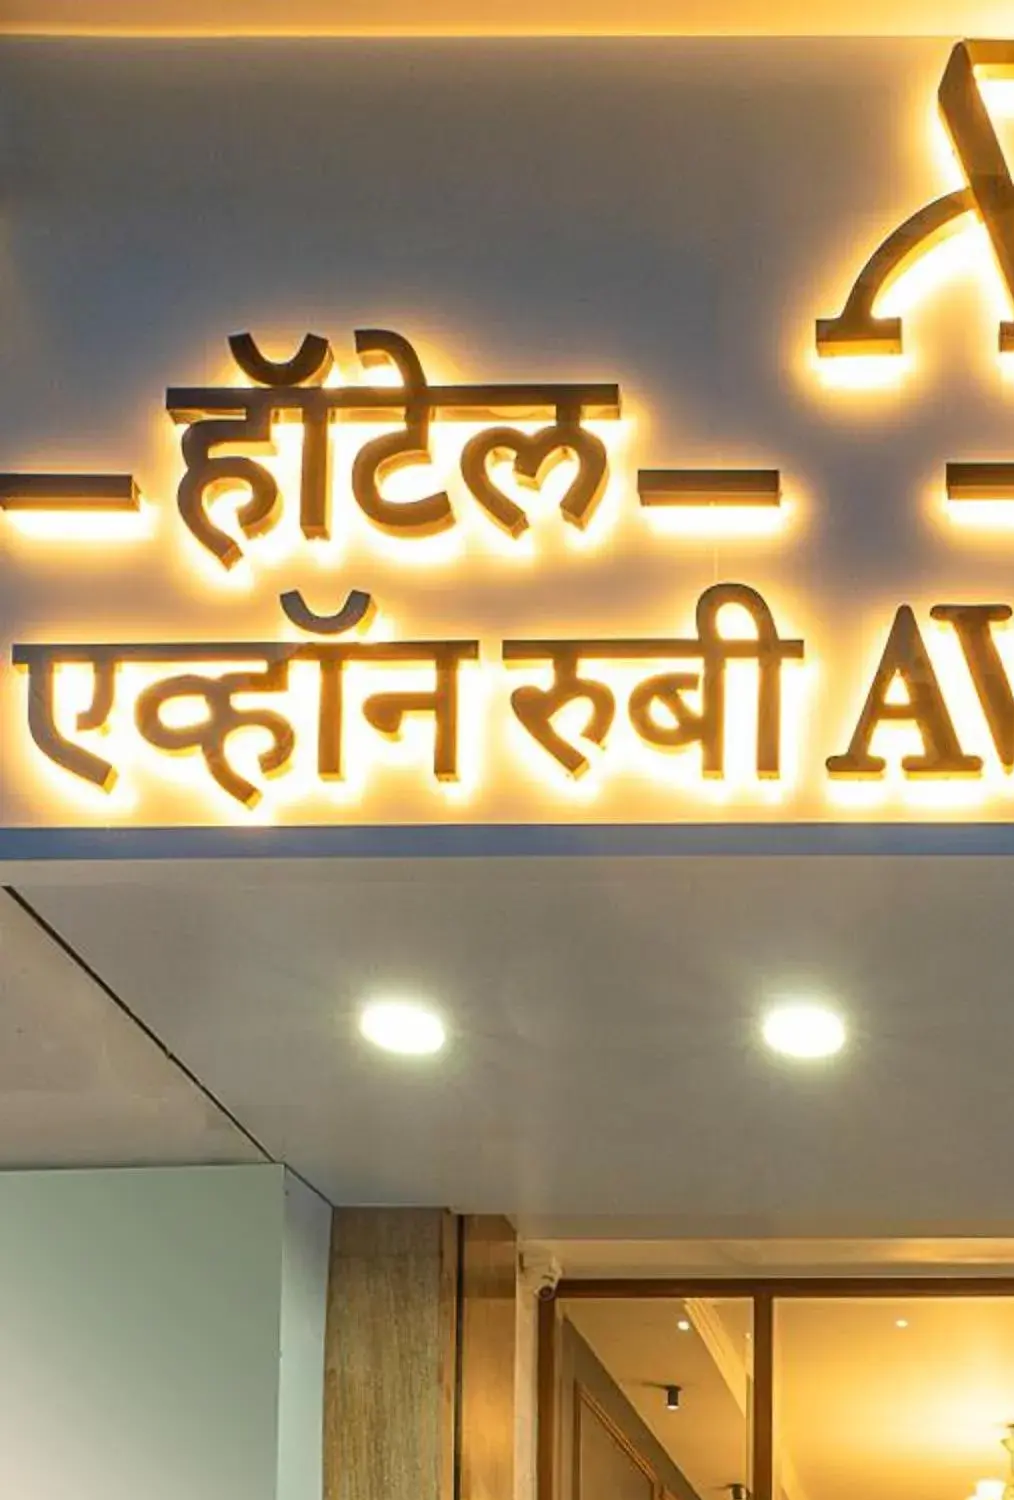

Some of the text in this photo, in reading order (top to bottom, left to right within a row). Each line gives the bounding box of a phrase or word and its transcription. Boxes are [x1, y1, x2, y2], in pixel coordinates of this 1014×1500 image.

[166, 330, 621, 571] हॉटेल
[12, 583, 805, 810] एव्हॉन रुबी
